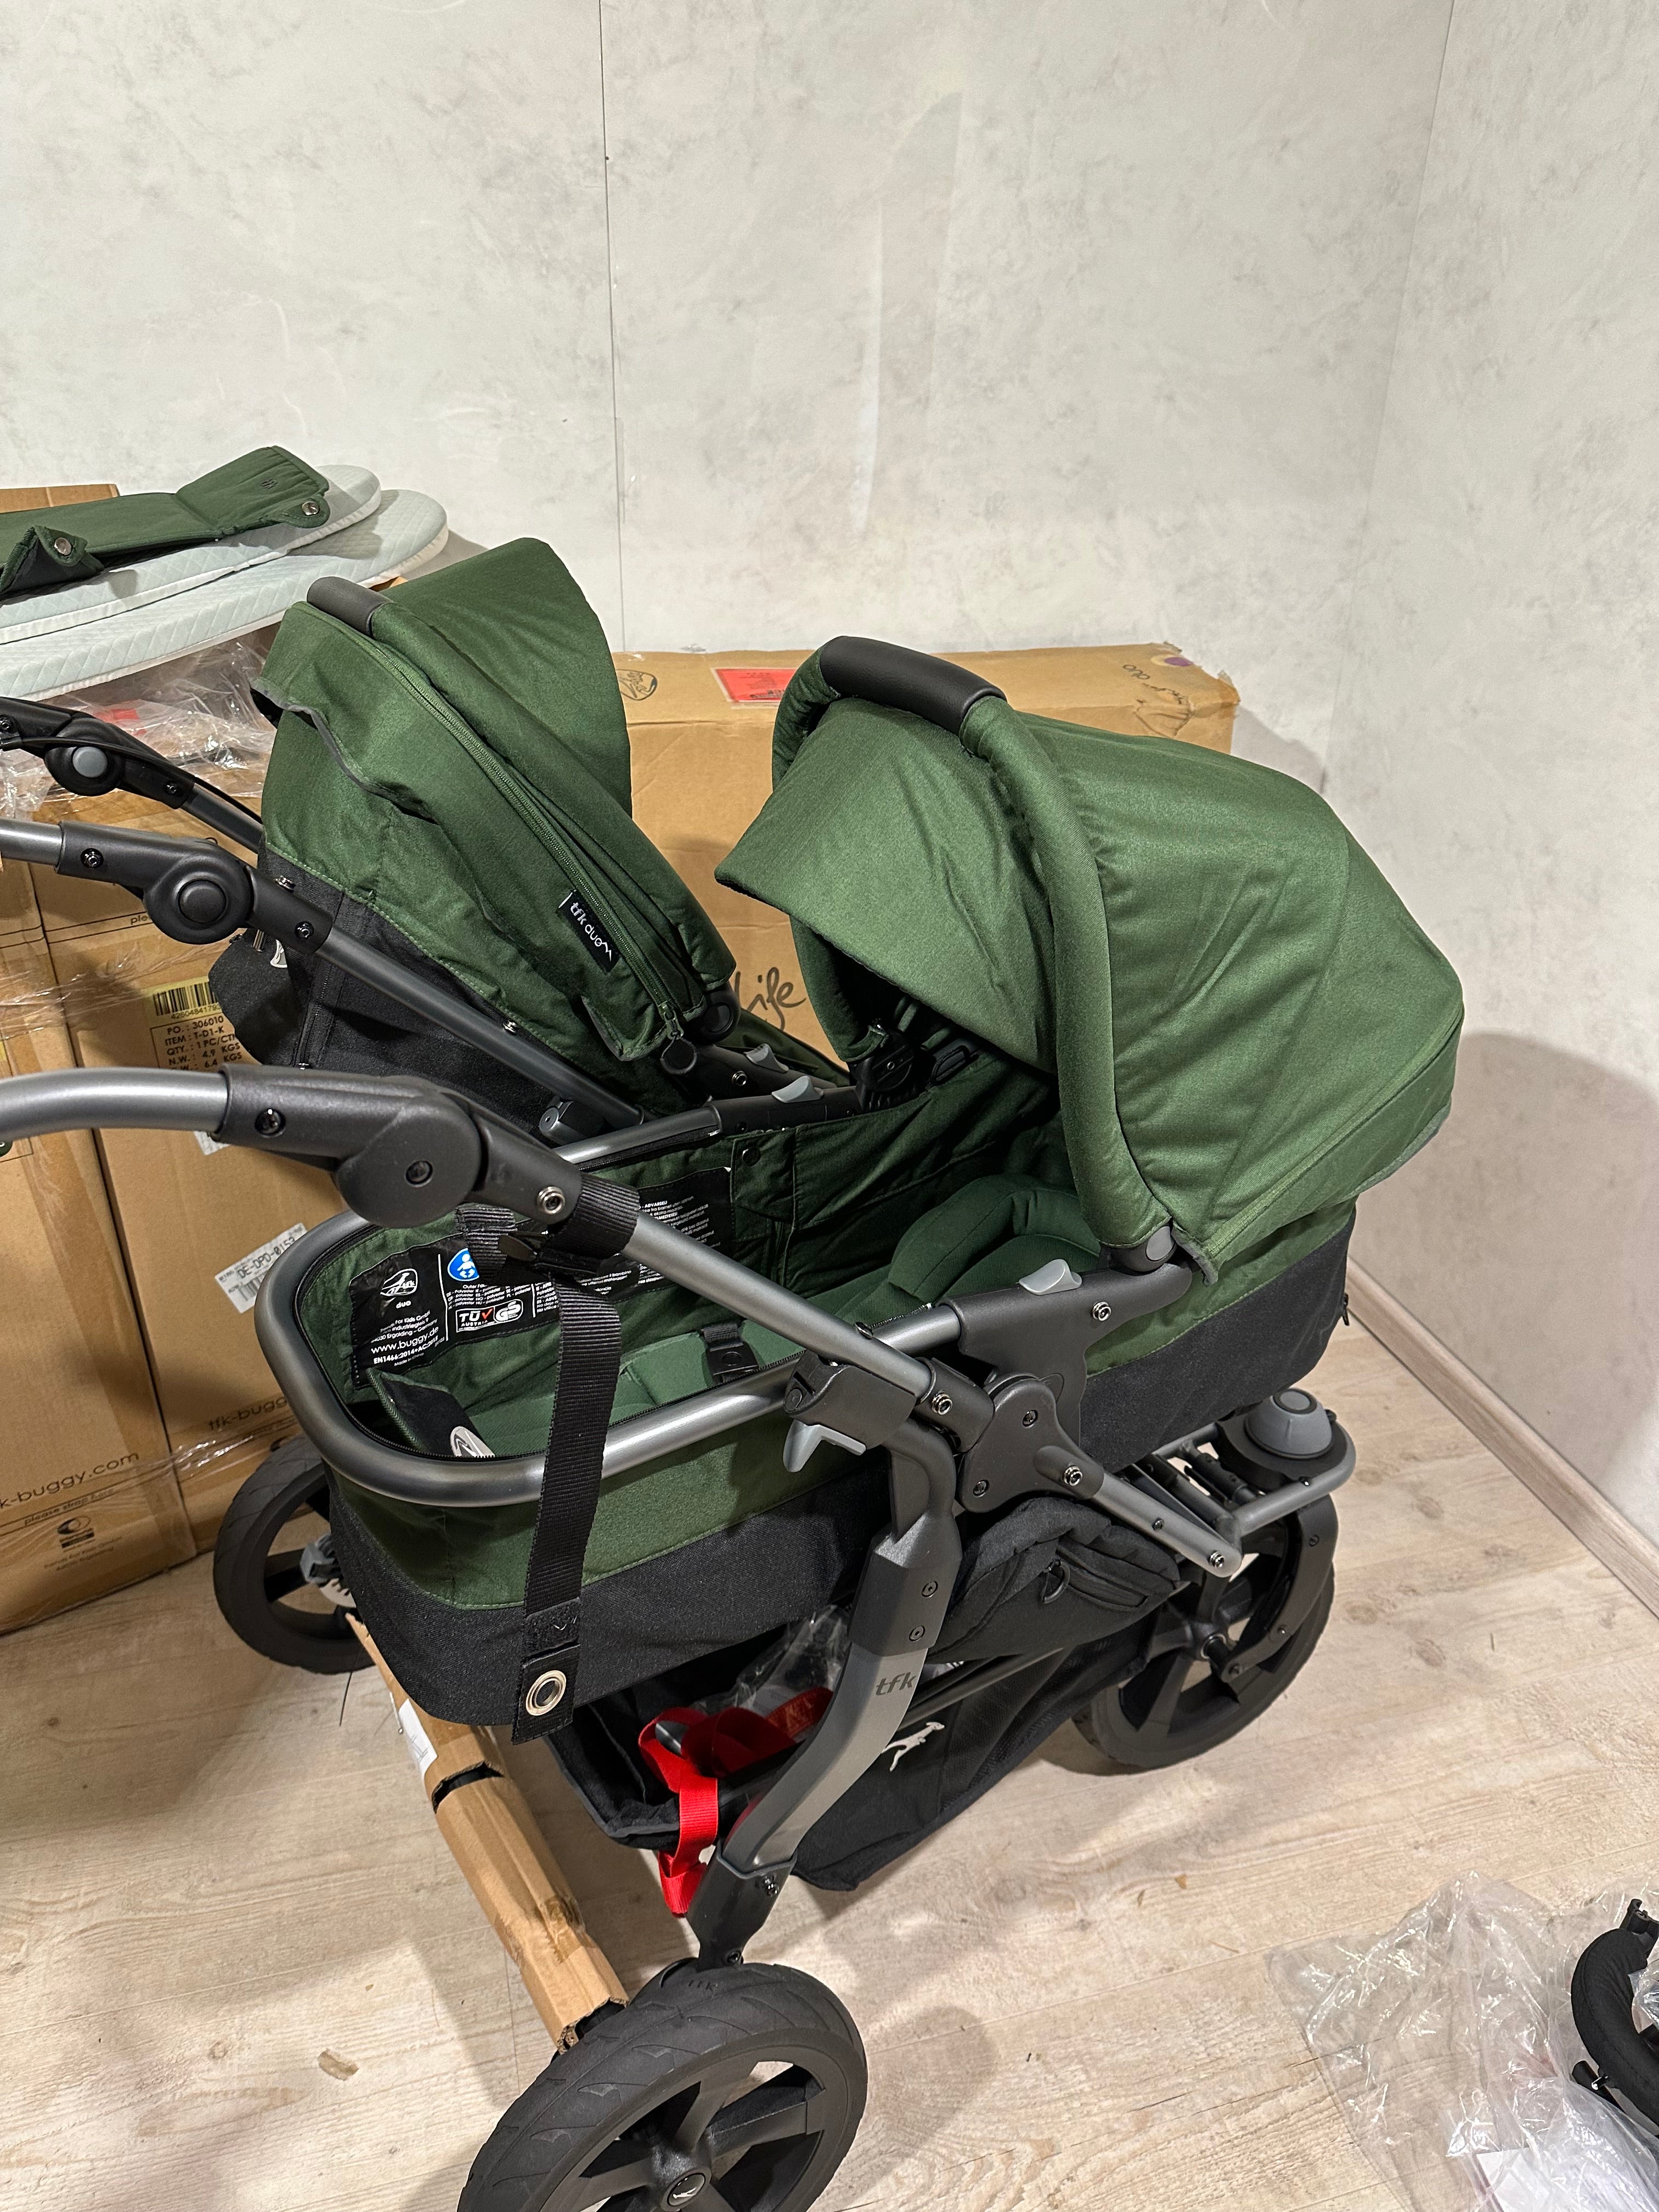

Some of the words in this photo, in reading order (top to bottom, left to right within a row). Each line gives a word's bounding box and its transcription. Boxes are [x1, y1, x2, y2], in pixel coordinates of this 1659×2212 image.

[131, 915, 149, 925] ple
[571, 902, 587, 925] tfk
[171, 1003, 222, 1019] 42604841793
[192, 1015, 224, 1029] 306010
[194, 1026, 224, 1040] T-D1-K
[202, 1049, 216, 1058] 4.9
[222, 1042, 240, 1053] KGS
[204, 1059, 218, 1069] 6.4
[223, 1052, 242, 1063] KGS
[396, 1300, 411, 1309] duo
[496, 1301, 521, 1322] GS
[370, 1327, 439, 1354] www.buggy.de
[208, 1396, 287, 1430] tfk-bugg
[0, 1452, 139, 1509] k-buggy.com
[876, 1672, 917, 1696] tfk
